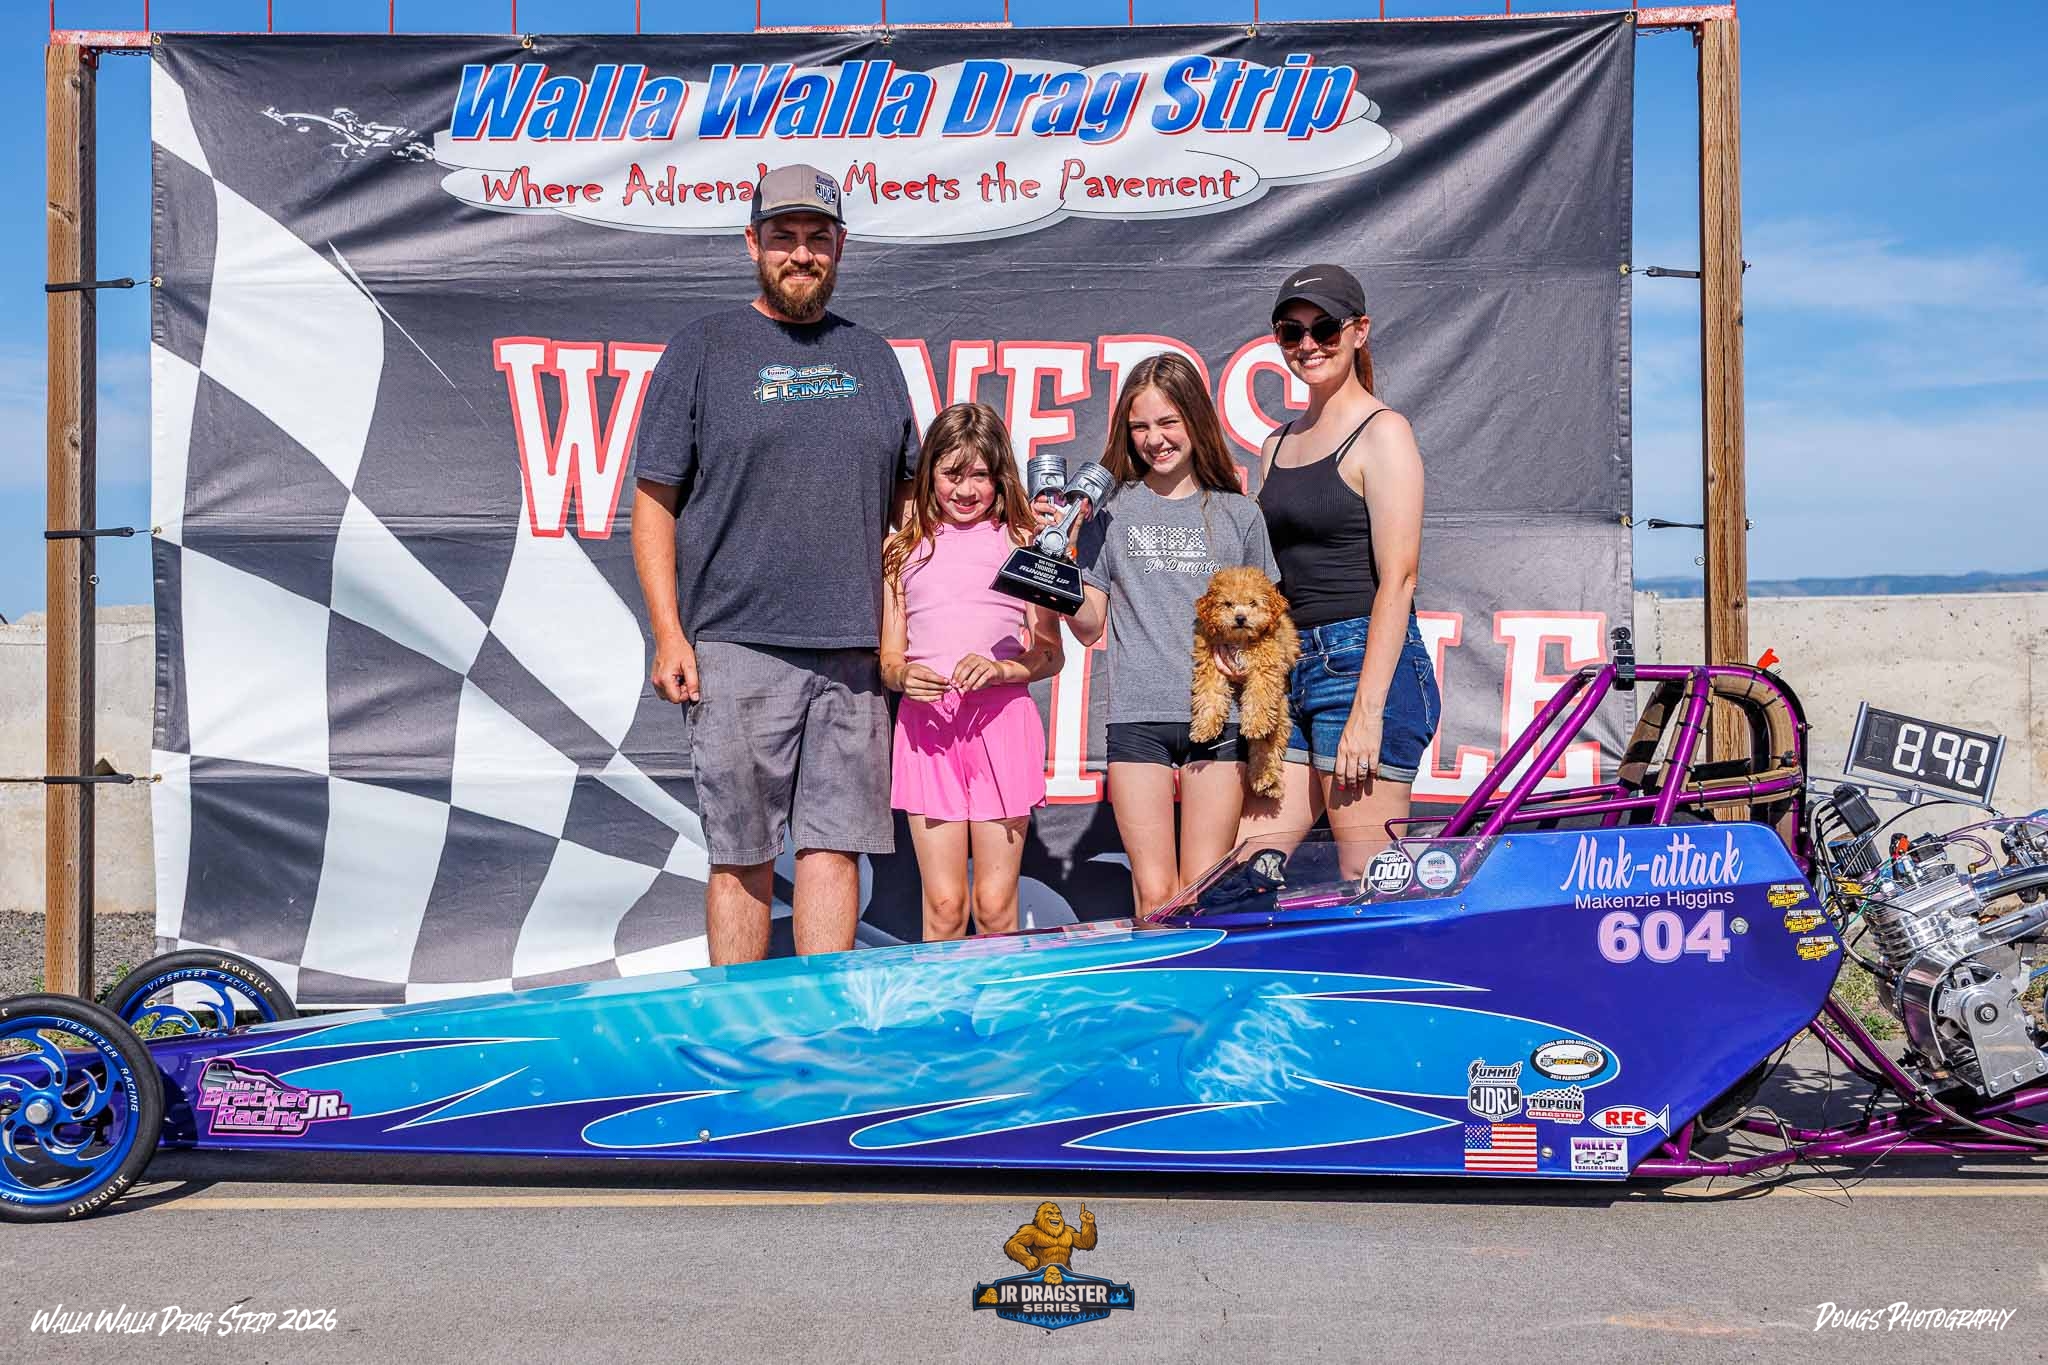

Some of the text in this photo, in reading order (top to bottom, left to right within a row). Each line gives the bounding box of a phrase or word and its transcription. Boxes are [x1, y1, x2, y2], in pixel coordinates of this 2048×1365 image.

[450, 53, 1359, 146] Walla Walla Drag Strip
[482, 165, 602, 208] Where
[842, 159, 960, 204] Meets
[977, 161, 1041, 202] the
[1059, 158, 1240, 202] Pavement
[1127, 525, 1206, 551] NHRA
[1019, 565, 1070, 585] RUNNER UP
[1165, 557, 1222, 578] Dragster
[1892, 722, 1990, 789] 8.90
[1369, 862, 1411, 881] .000
[1560, 831, 1744, 891] Mak-attack
[1575, 889, 1735, 910] Makenzie Higgins
[1597, 909, 1731, 964] 604
[147, 970, 258, 998] VIPERIZER RACING
[56, 1019, 139, 1113] VIPERIZER RACING
[202, 1087, 311, 1109] Bracket
[300, 1094, 348, 1120] JR.
[1471, 1087, 1518, 1115] JDRL
[1530, 1098, 1582, 1110] TOPGUN
[215, 1104, 306, 1129] Racing
[1528, 1110, 1583, 1119] DRAGSTRIP
[1605, 1111, 1647, 1126] RFC
[1573, 1139, 1625, 1151] VALLEY
